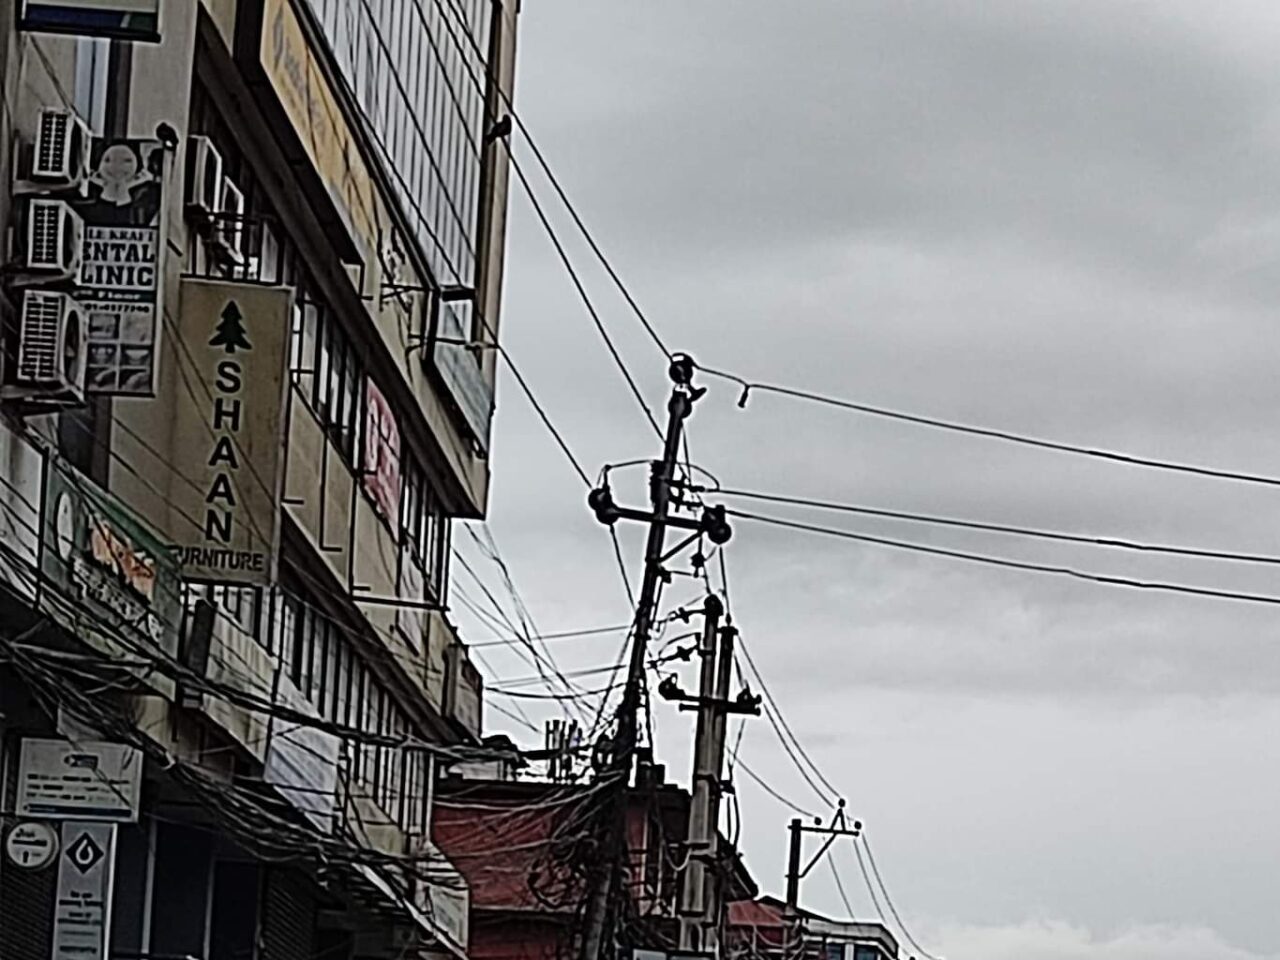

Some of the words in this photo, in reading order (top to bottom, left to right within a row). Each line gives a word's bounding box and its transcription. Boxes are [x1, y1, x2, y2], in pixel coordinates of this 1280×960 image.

[82, 241, 155, 263] ENTAL
[81, 263, 154, 287] LINIC
[205, 361, 242, 543] SHAAN
[179, 546, 264, 572] URNITURE
